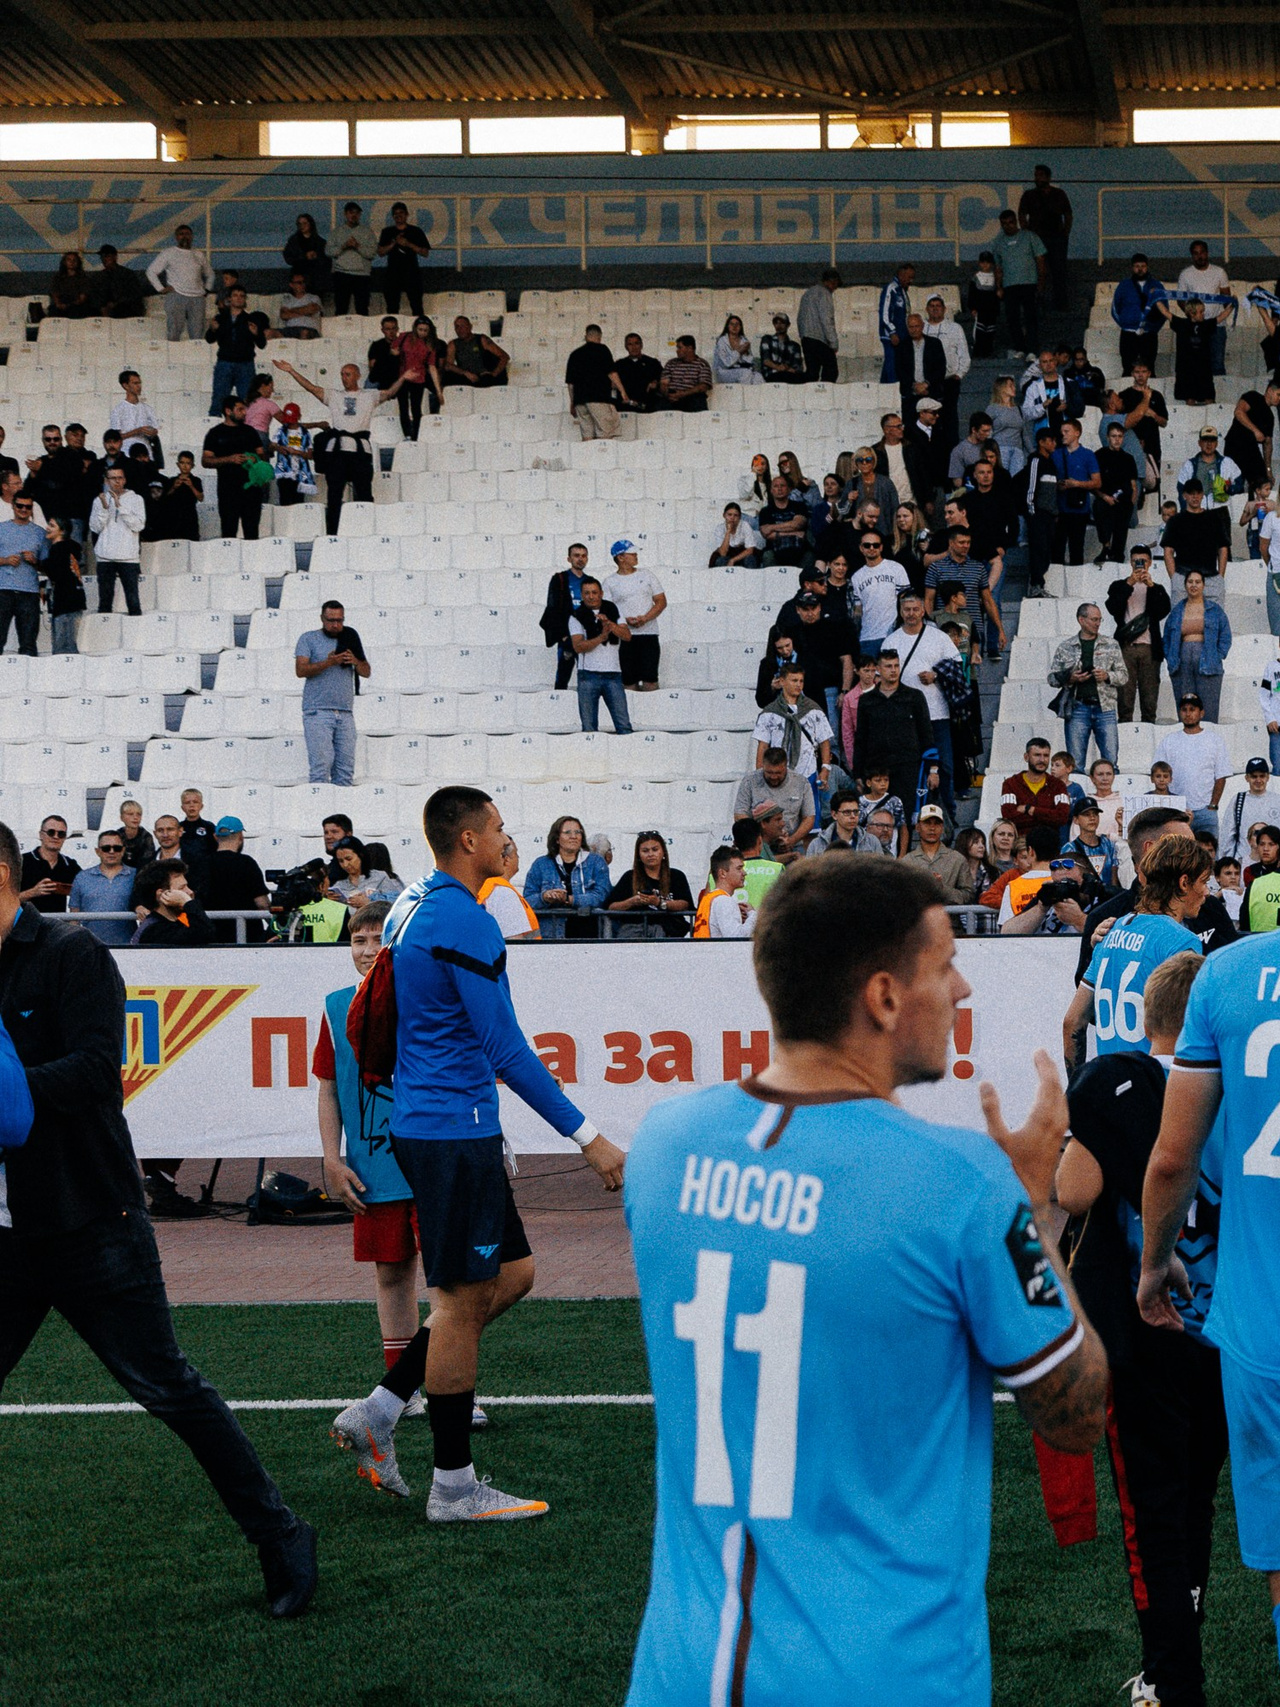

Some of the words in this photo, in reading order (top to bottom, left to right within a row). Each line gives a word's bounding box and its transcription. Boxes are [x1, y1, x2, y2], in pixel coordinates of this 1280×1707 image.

[529, 185, 1023, 247] ЧЕЛЯБИНС
[874, 574, 895, 584] YORK
[1095, 957, 1147, 1043] 66
[603, 1030, 695, 1084] за
[678, 1153, 824, 1236] НОСОВ
[673, 1248, 807, 1520] 11
